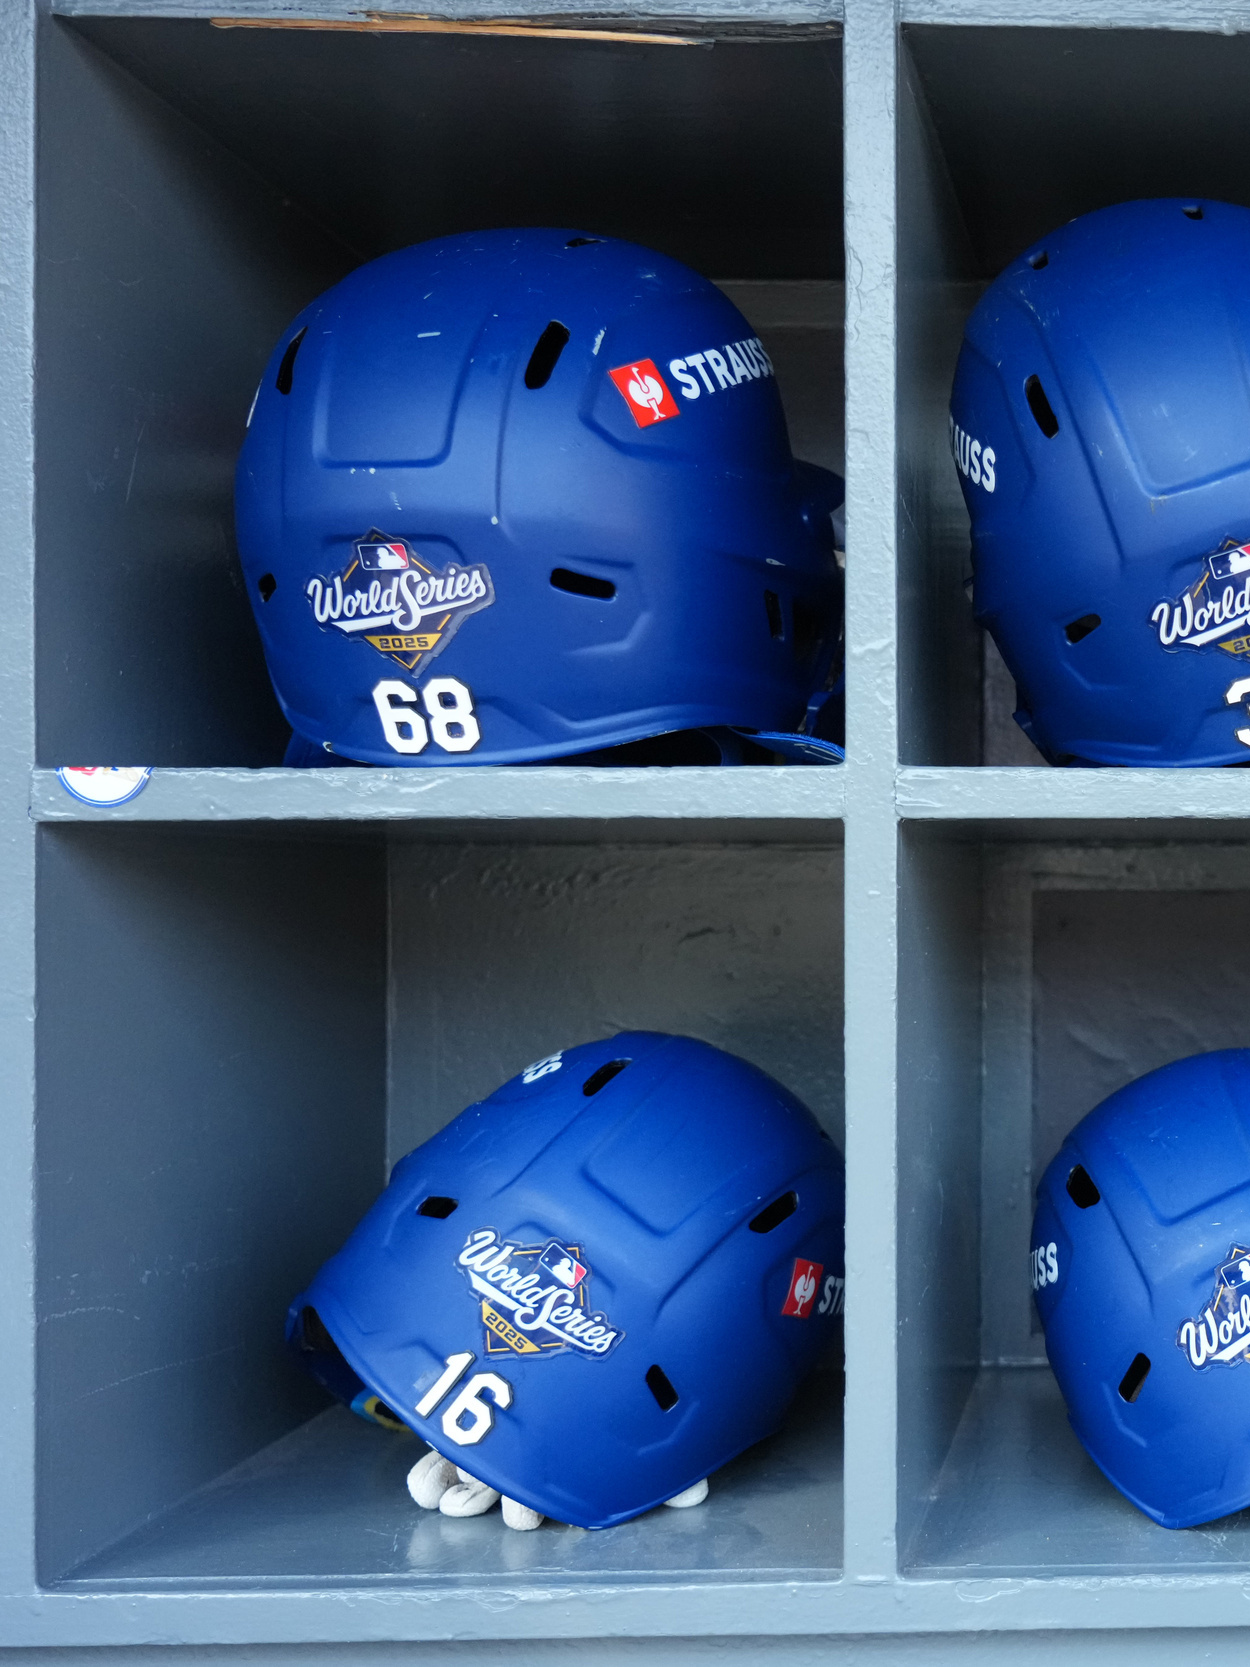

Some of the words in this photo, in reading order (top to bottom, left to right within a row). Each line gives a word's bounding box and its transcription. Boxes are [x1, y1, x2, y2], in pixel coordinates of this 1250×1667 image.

[949, 414, 996, 493] AUSS
[307, 575, 402, 623] World
[392, 568, 487, 632] Series
[378, 634, 430, 650] 2025
[371, 676, 482, 755] 68
[458, 1231, 557, 1309] World
[514, 1288, 618, 1353] Series
[485, 1312, 529, 1350] 2025
[414, 1352, 513, 1446] 16
